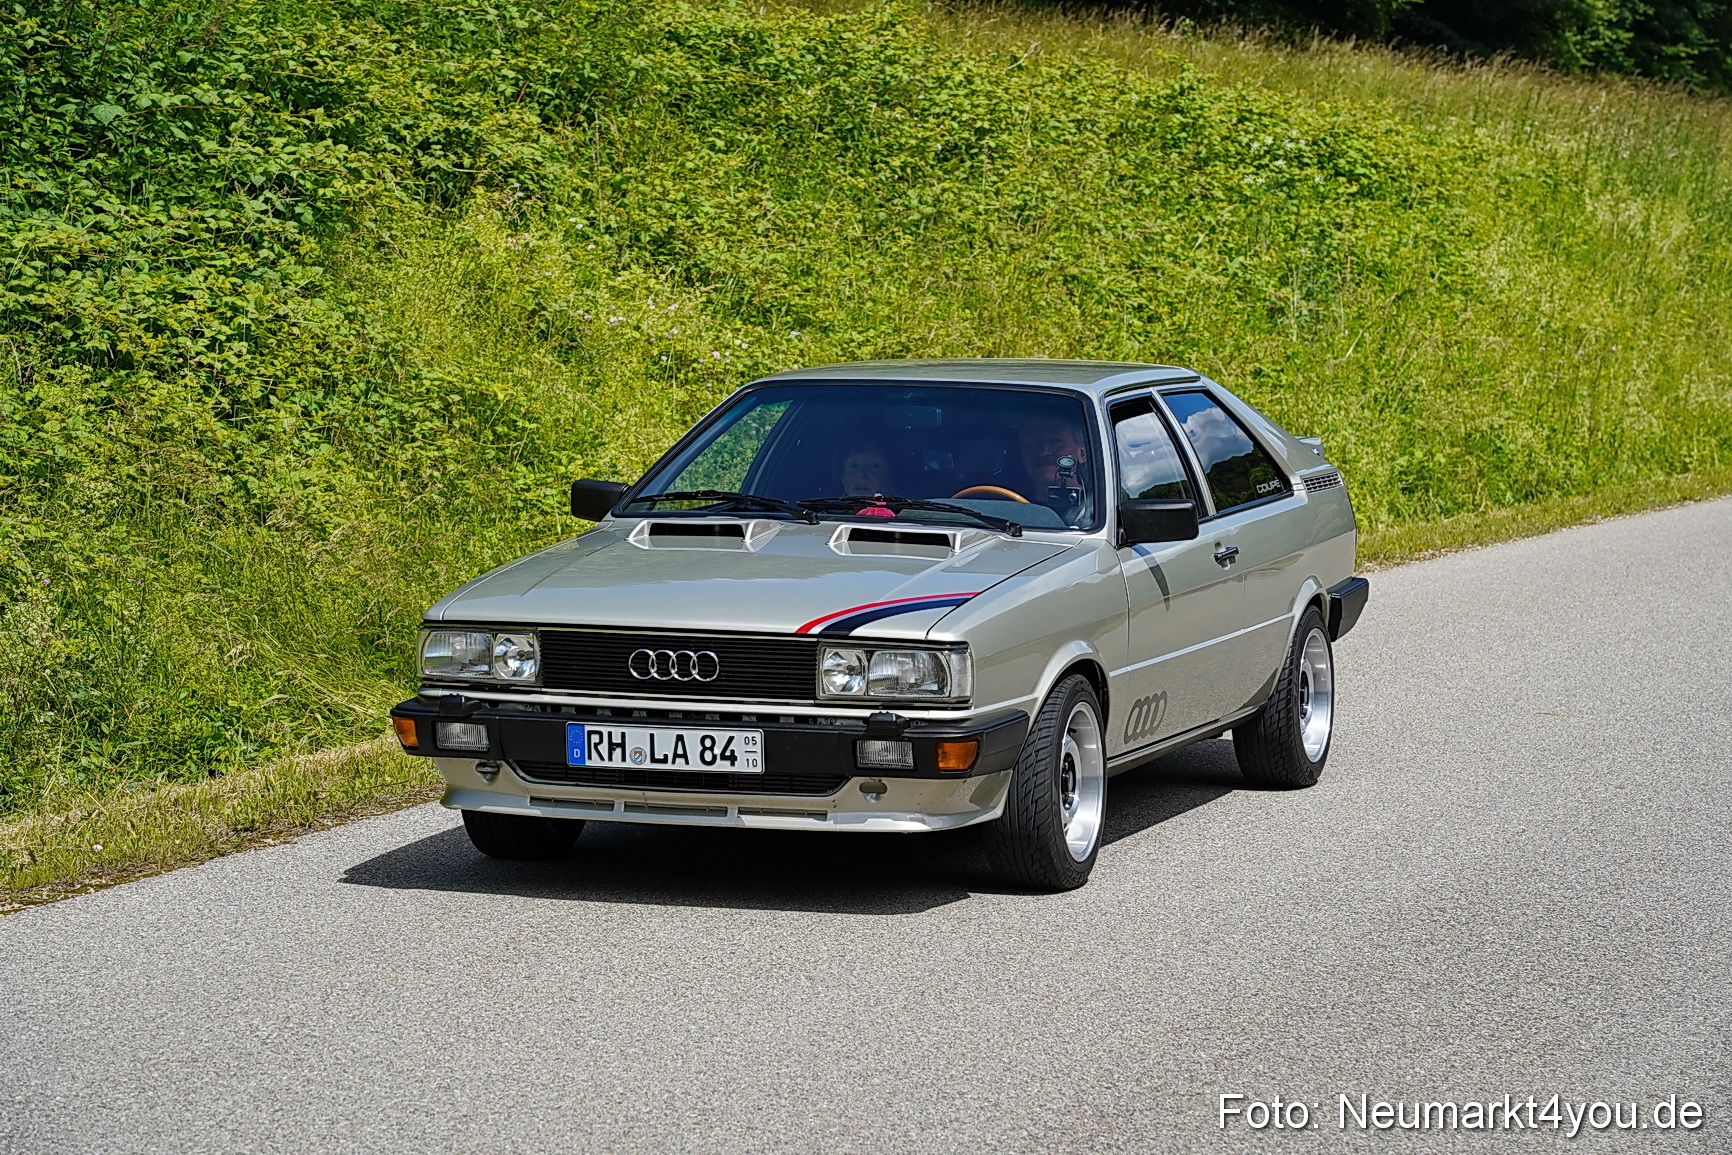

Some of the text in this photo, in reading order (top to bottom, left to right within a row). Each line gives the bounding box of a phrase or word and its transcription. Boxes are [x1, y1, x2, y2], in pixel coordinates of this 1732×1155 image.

[744, 736, 757, 746] 05
[587, 730, 738, 766] RH LA 84
[573, 749, 580, 758] D
[745, 758, 758, 768] 10
